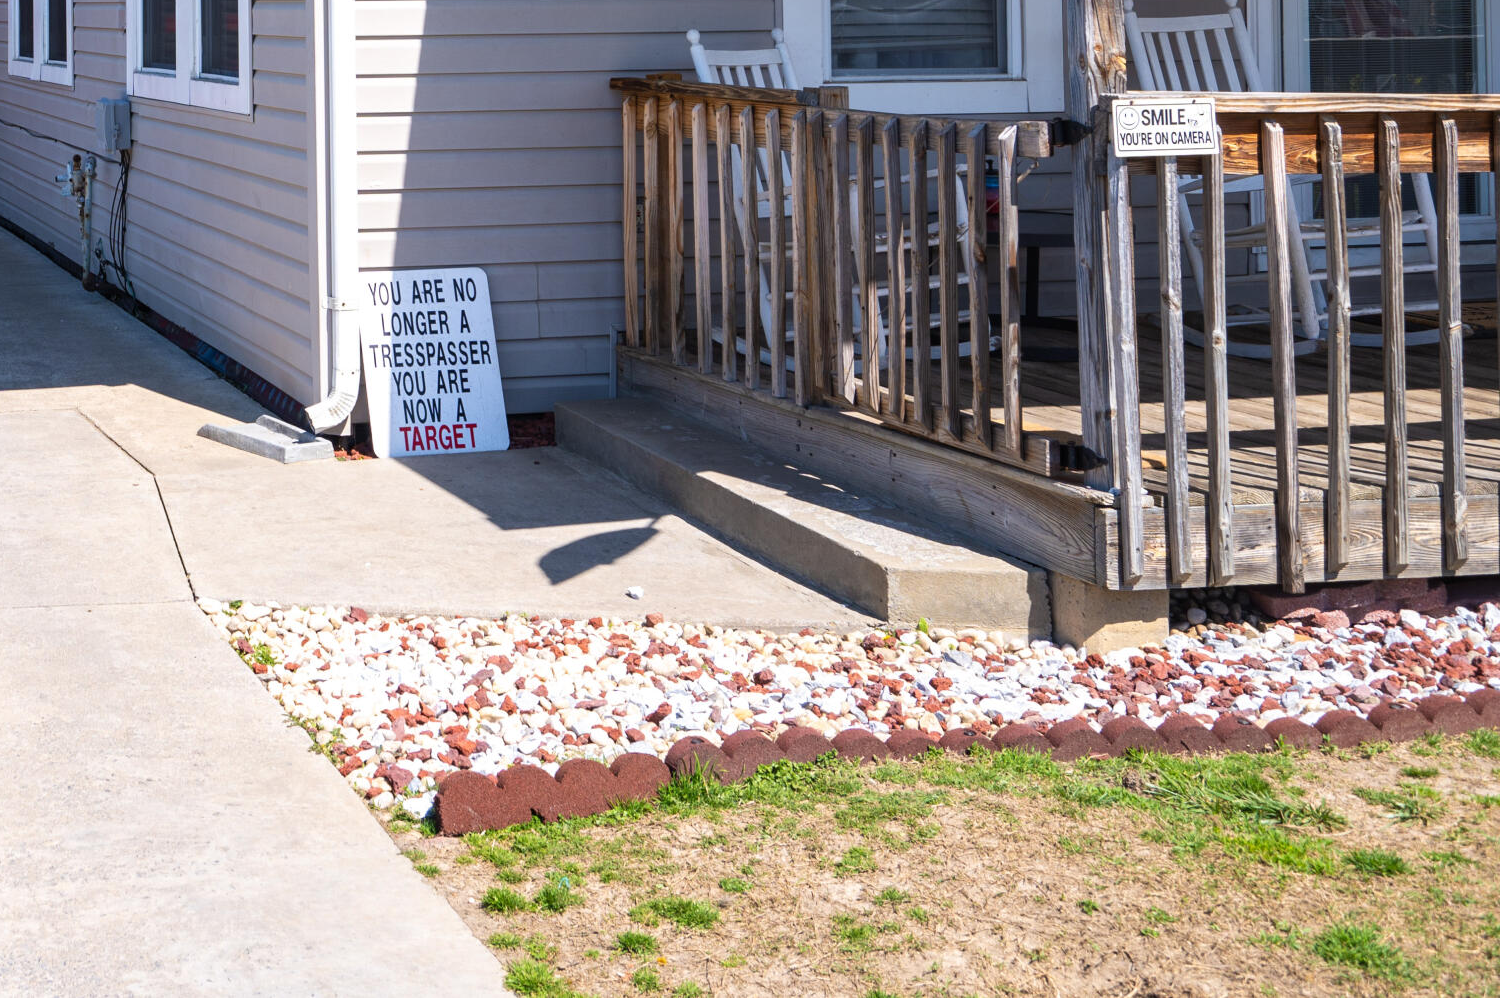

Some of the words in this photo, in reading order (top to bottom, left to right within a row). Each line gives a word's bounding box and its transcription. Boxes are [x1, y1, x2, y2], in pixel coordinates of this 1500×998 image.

[1141, 108, 1186, 126] SMILE
[1119, 132, 1153, 146] YOU'RE
[1154, 131, 1169, 145] ON
[1171, 130, 1212, 145] CAMERA
[367, 281, 402, 306] YOU
[412, 279, 446, 304] ARE
[453, 277, 477, 302] NO
[380, 310, 450, 337] LONGER
[460, 309, 471, 334] A
[368, 340, 492, 368] TRESSPASSER
[391, 371, 426, 396] YOU
[437, 369, 471, 394] ARE
[403, 398, 442, 424] NOW
[456, 397, 467, 422] A
[399, 423, 478, 452] TARGET
